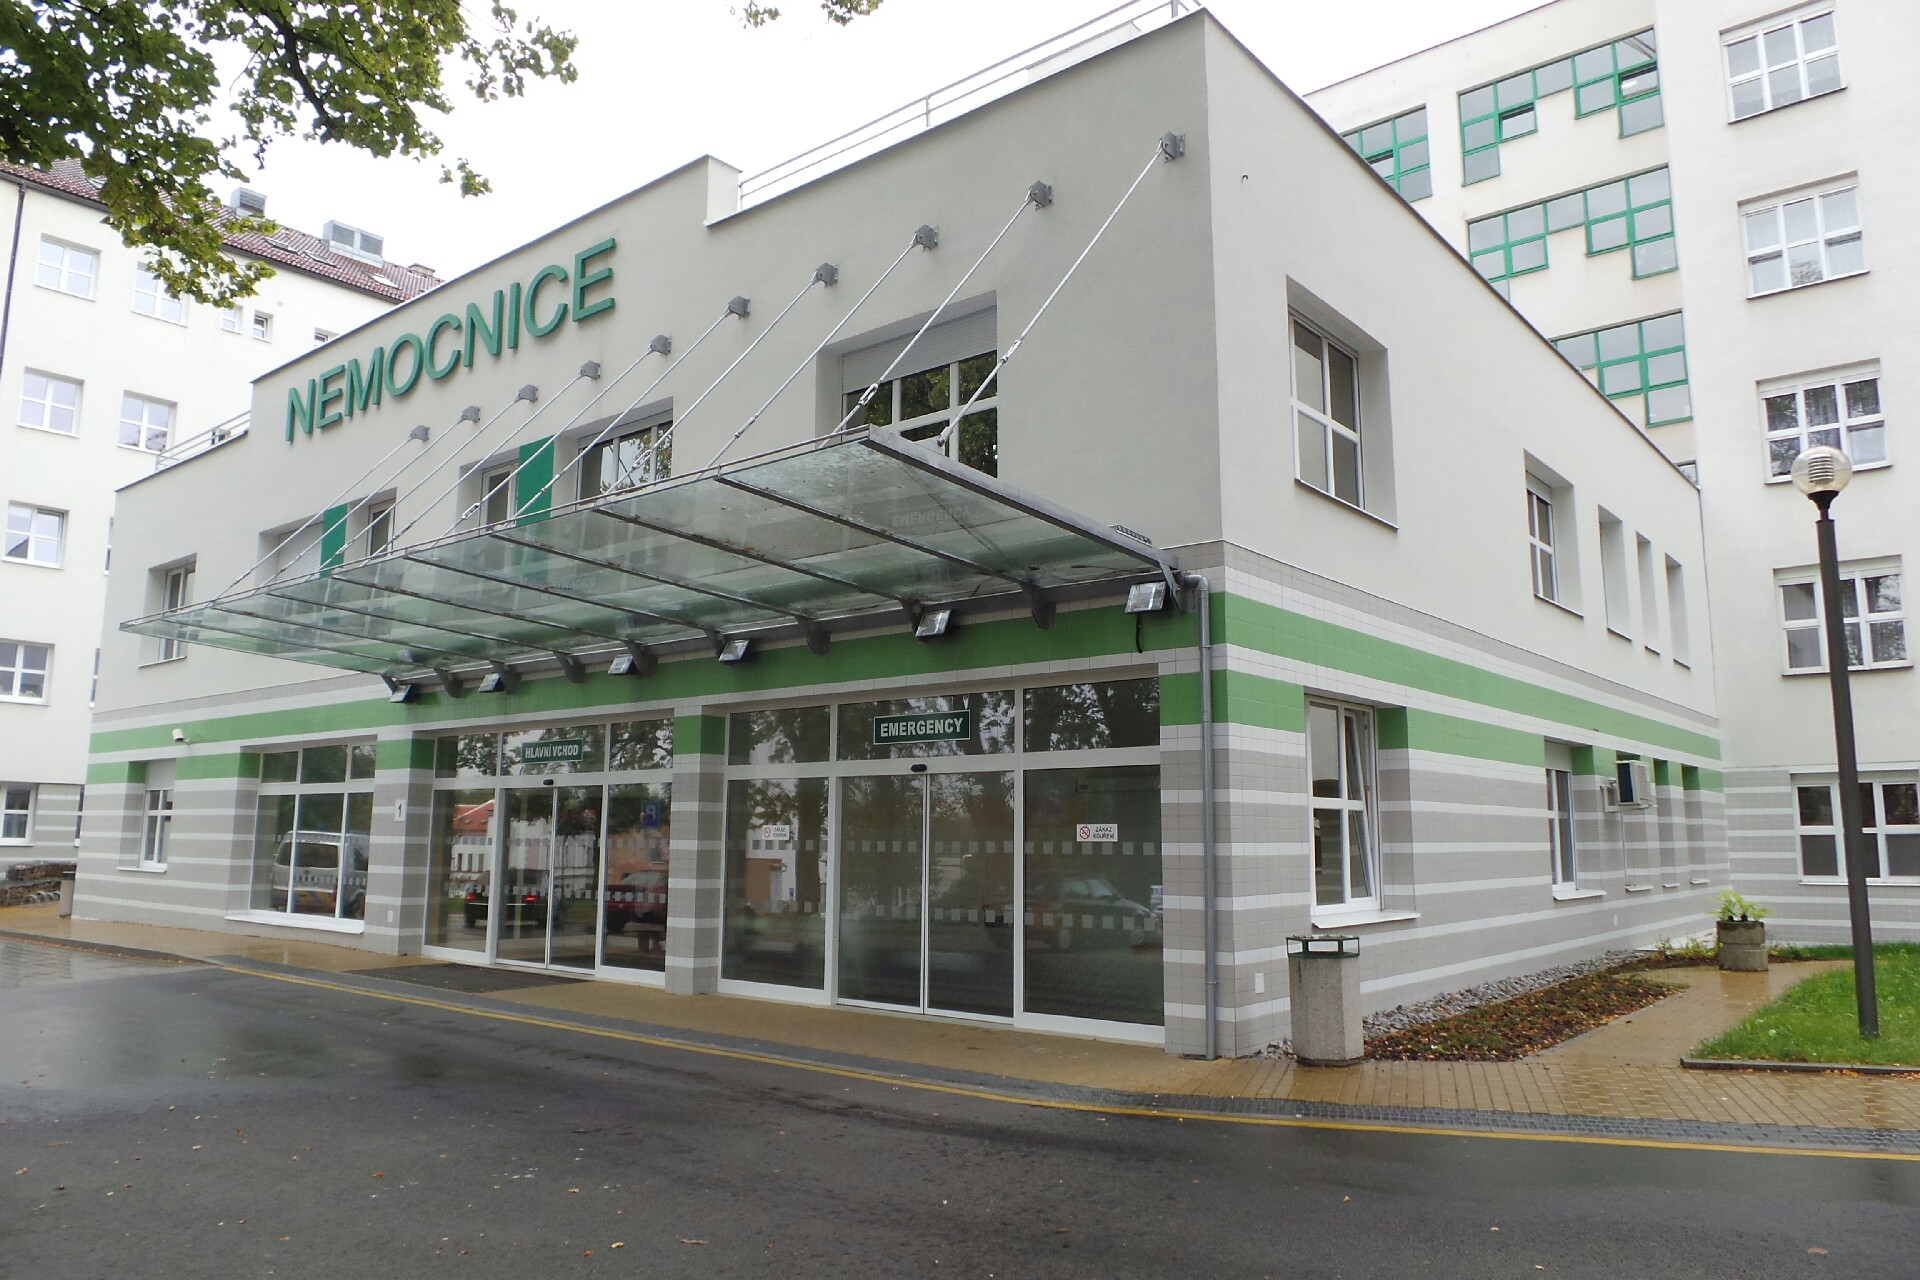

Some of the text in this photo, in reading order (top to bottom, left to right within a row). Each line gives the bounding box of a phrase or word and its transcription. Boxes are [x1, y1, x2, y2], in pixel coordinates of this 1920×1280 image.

[285, 237, 616, 443] NEMOCNICE
[880, 717, 964, 737] EMERGENCY
[525, 743, 579, 758] HLAVNÍ VCHOD
[397, 803, 402, 818] 1
[1095, 825, 1112, 833] ZÁKAZ
